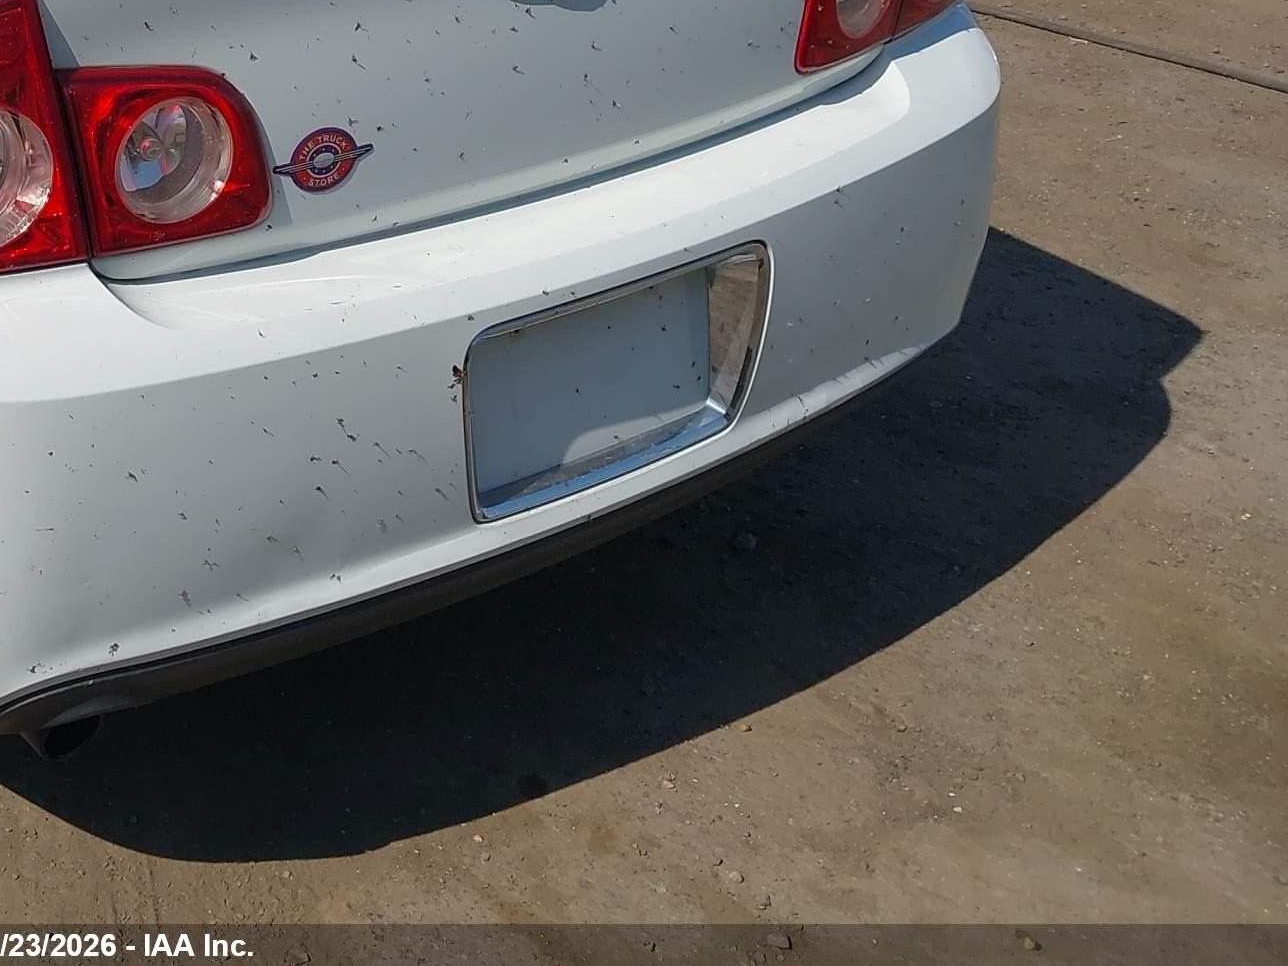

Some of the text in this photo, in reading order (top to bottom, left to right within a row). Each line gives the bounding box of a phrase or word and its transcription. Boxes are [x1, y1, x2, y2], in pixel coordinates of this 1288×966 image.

[298, 134, 349, 161] THE TRUCK
[308, 171, 341, 187] STORE
